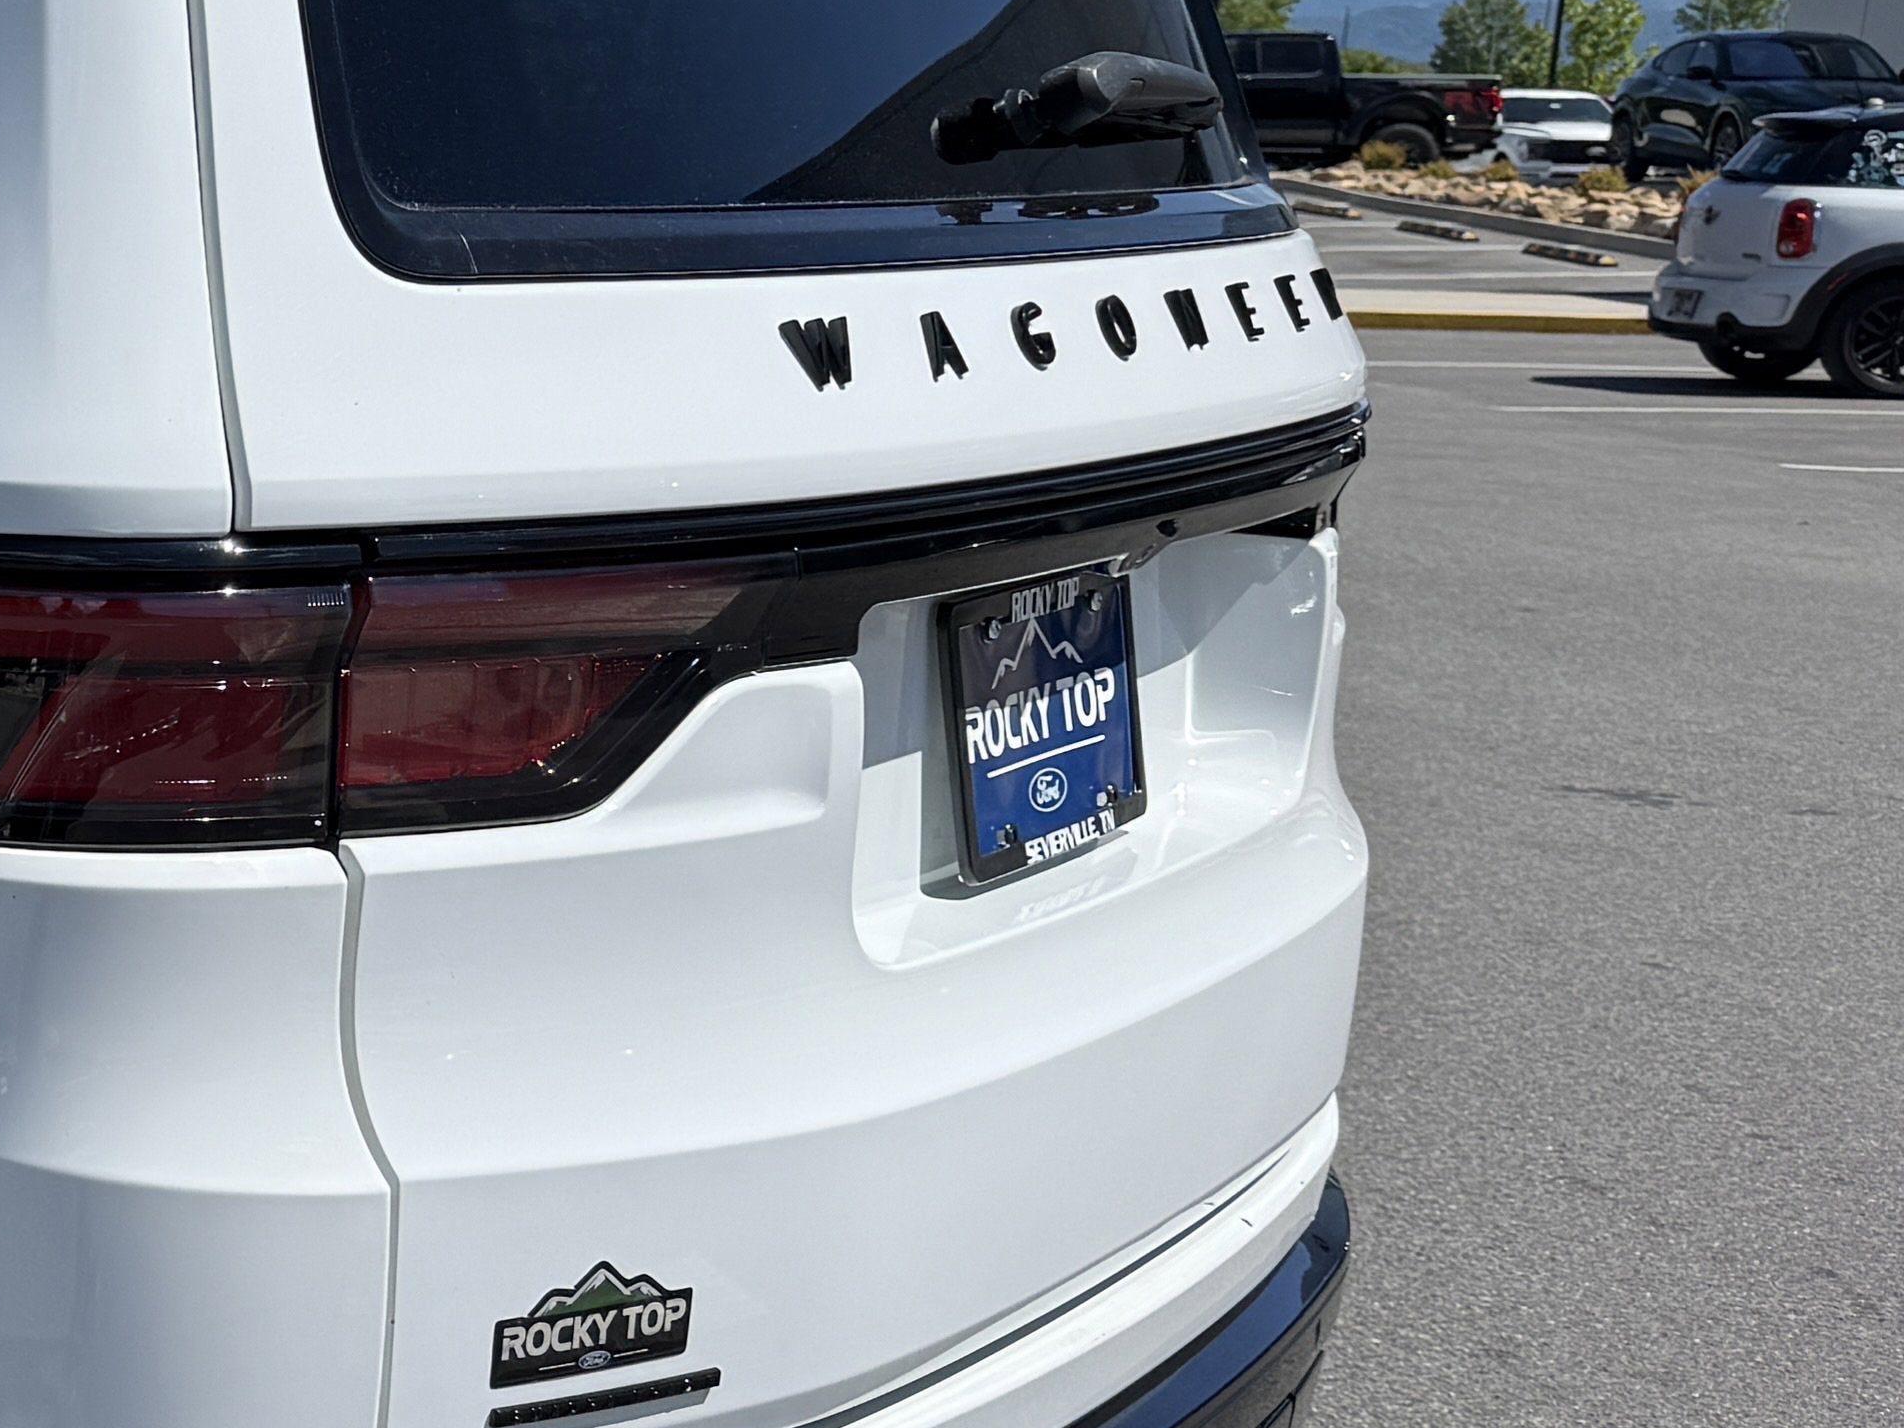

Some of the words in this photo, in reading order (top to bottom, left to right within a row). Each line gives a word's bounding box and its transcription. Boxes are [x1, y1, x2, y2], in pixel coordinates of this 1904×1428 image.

[1011, 582, 1053, 623] ROCKY
[1056, 576, 1080, 612] TOP
[965, 682, 1050, 764] ROCKY
[1056, 667, 1115, 733] TOP
[1098, 808, 1116, 834] TN
[501, 1310, 617, 1361] ROCKY
[623, 1297, 687, 1340] TOP
